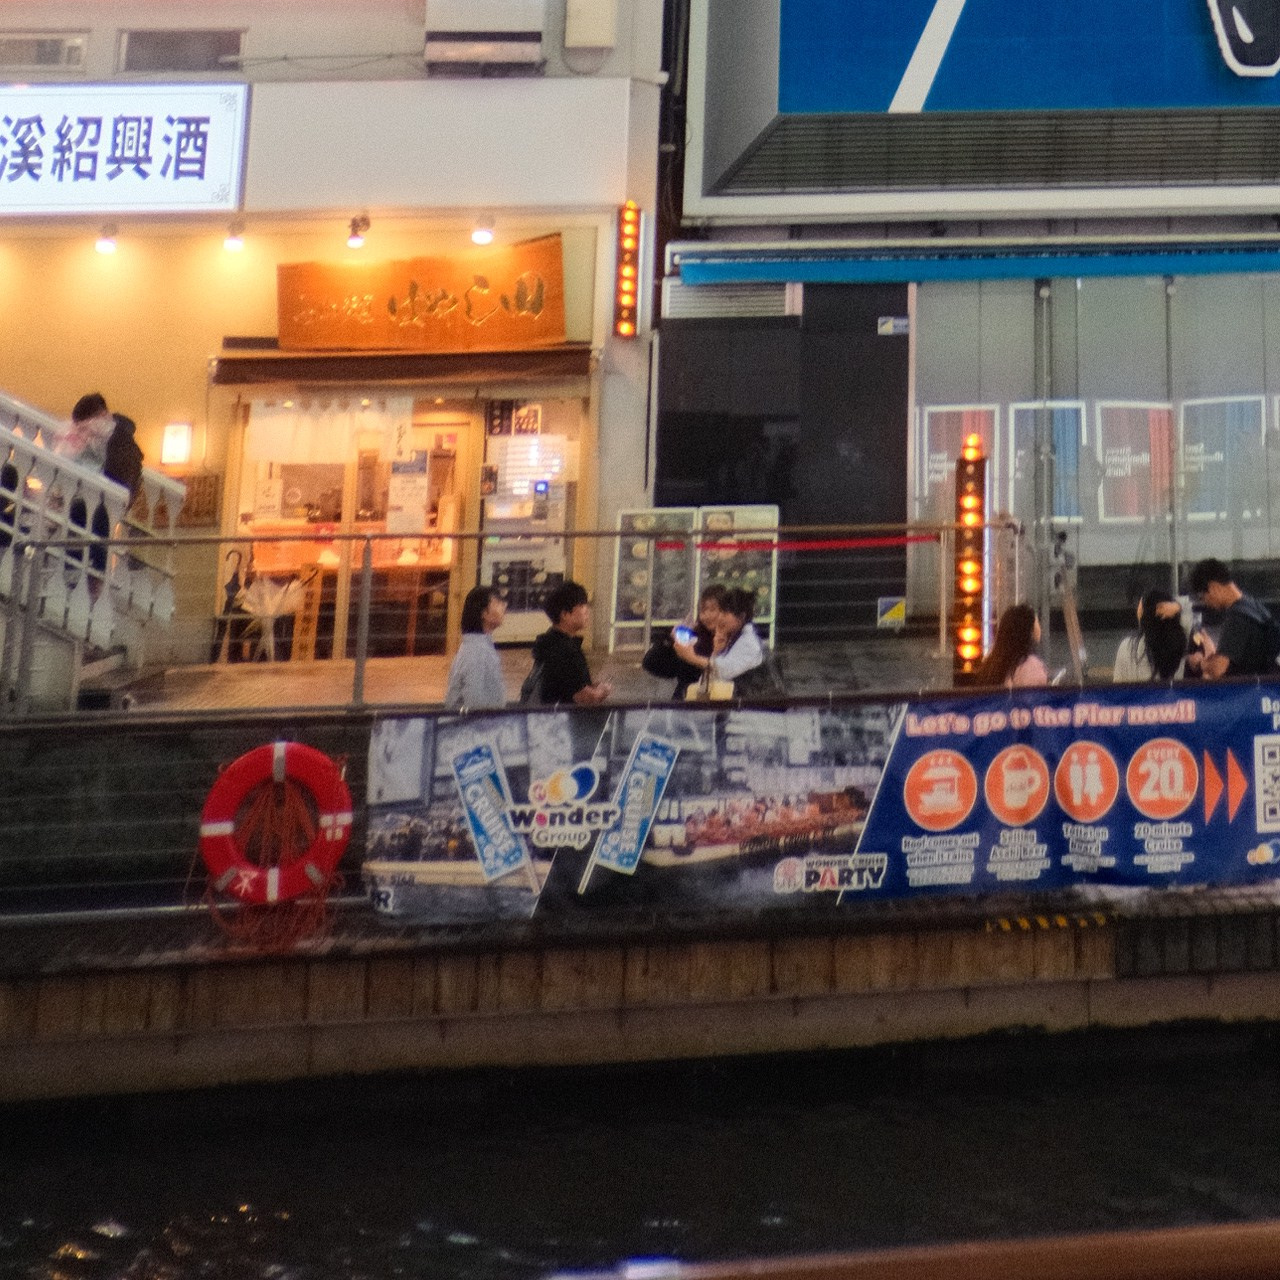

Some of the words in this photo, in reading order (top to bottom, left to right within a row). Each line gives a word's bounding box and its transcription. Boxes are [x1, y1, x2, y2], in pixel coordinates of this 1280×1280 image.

[906, 713, 970, 737] Let's
[974, 711, 1007, 736] go
[1010, 707, 1031, 730] to
[1033, 705, 1072, 727] the
[1073, 703, 1125, 727] Pier
[1139, 759, 1184, 800] 20
[510, 807, 617, 828] Wonder
[804, 867, 884, 888] PARTY
